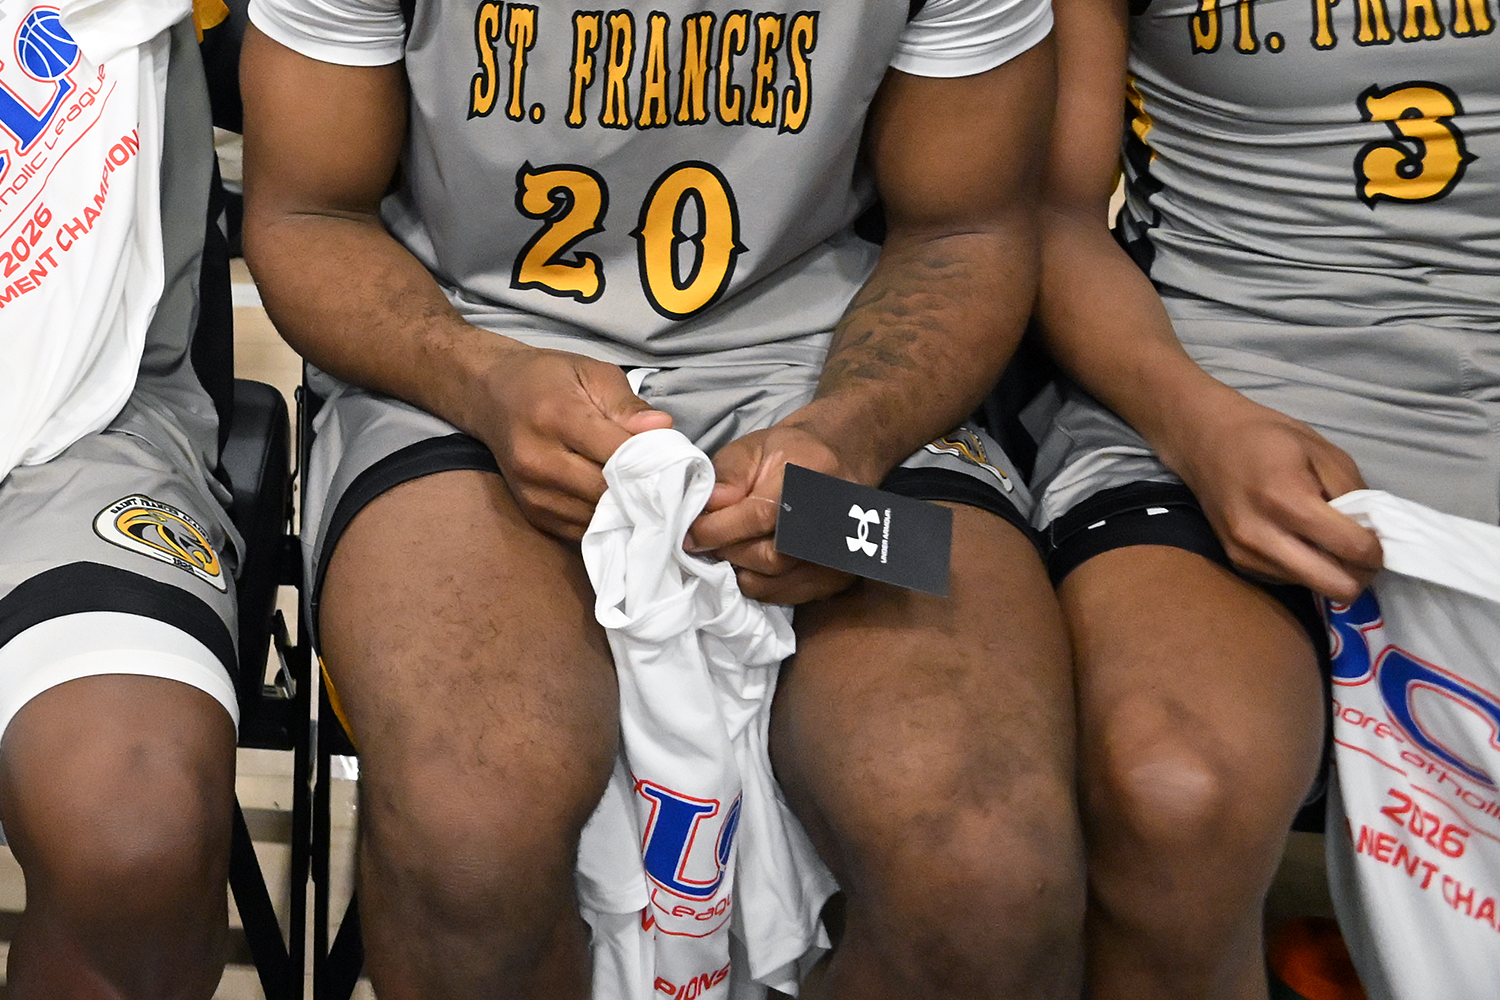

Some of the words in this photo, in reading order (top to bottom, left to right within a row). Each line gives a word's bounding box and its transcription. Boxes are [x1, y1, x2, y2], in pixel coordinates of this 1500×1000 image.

[44, 63, 106, 151] League
[564, 9, 821, 136] FRANCES
[1354, 80, 1479, 211] 3
[509, 160, 750, 322] 20
[110, 498, 138, 514] SAINT
[882, 508, 892, 540] ARMOUR
[880, 539, 889, 564] UNDER
[1380, 787, 1471, 859] 2026
[1441, 874, 1500, 934] CHA
